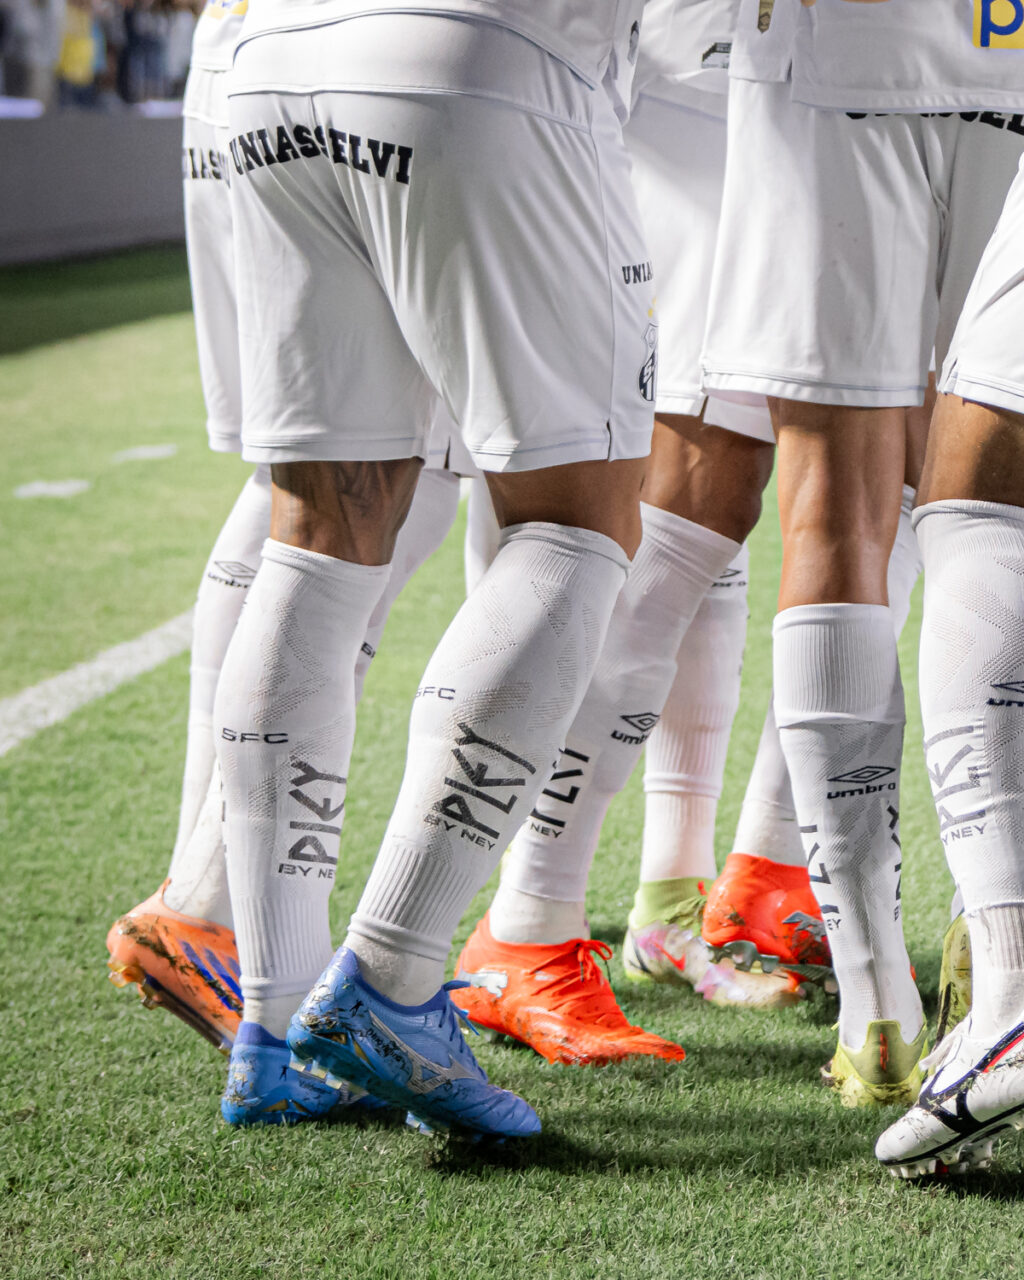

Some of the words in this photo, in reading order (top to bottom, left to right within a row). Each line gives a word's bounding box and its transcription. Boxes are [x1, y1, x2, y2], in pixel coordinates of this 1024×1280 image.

[228, 123, 414, 186] UNIASSELVI
[221, 727, 289, 745] SFC
[826, 782, 897, 800] umbro
[530, 822, 563, 839] NEY
[951, 822, 988, 841] NEY
[460, 828, 496, 852] NEY
[277, 863, 313, 878] BY
